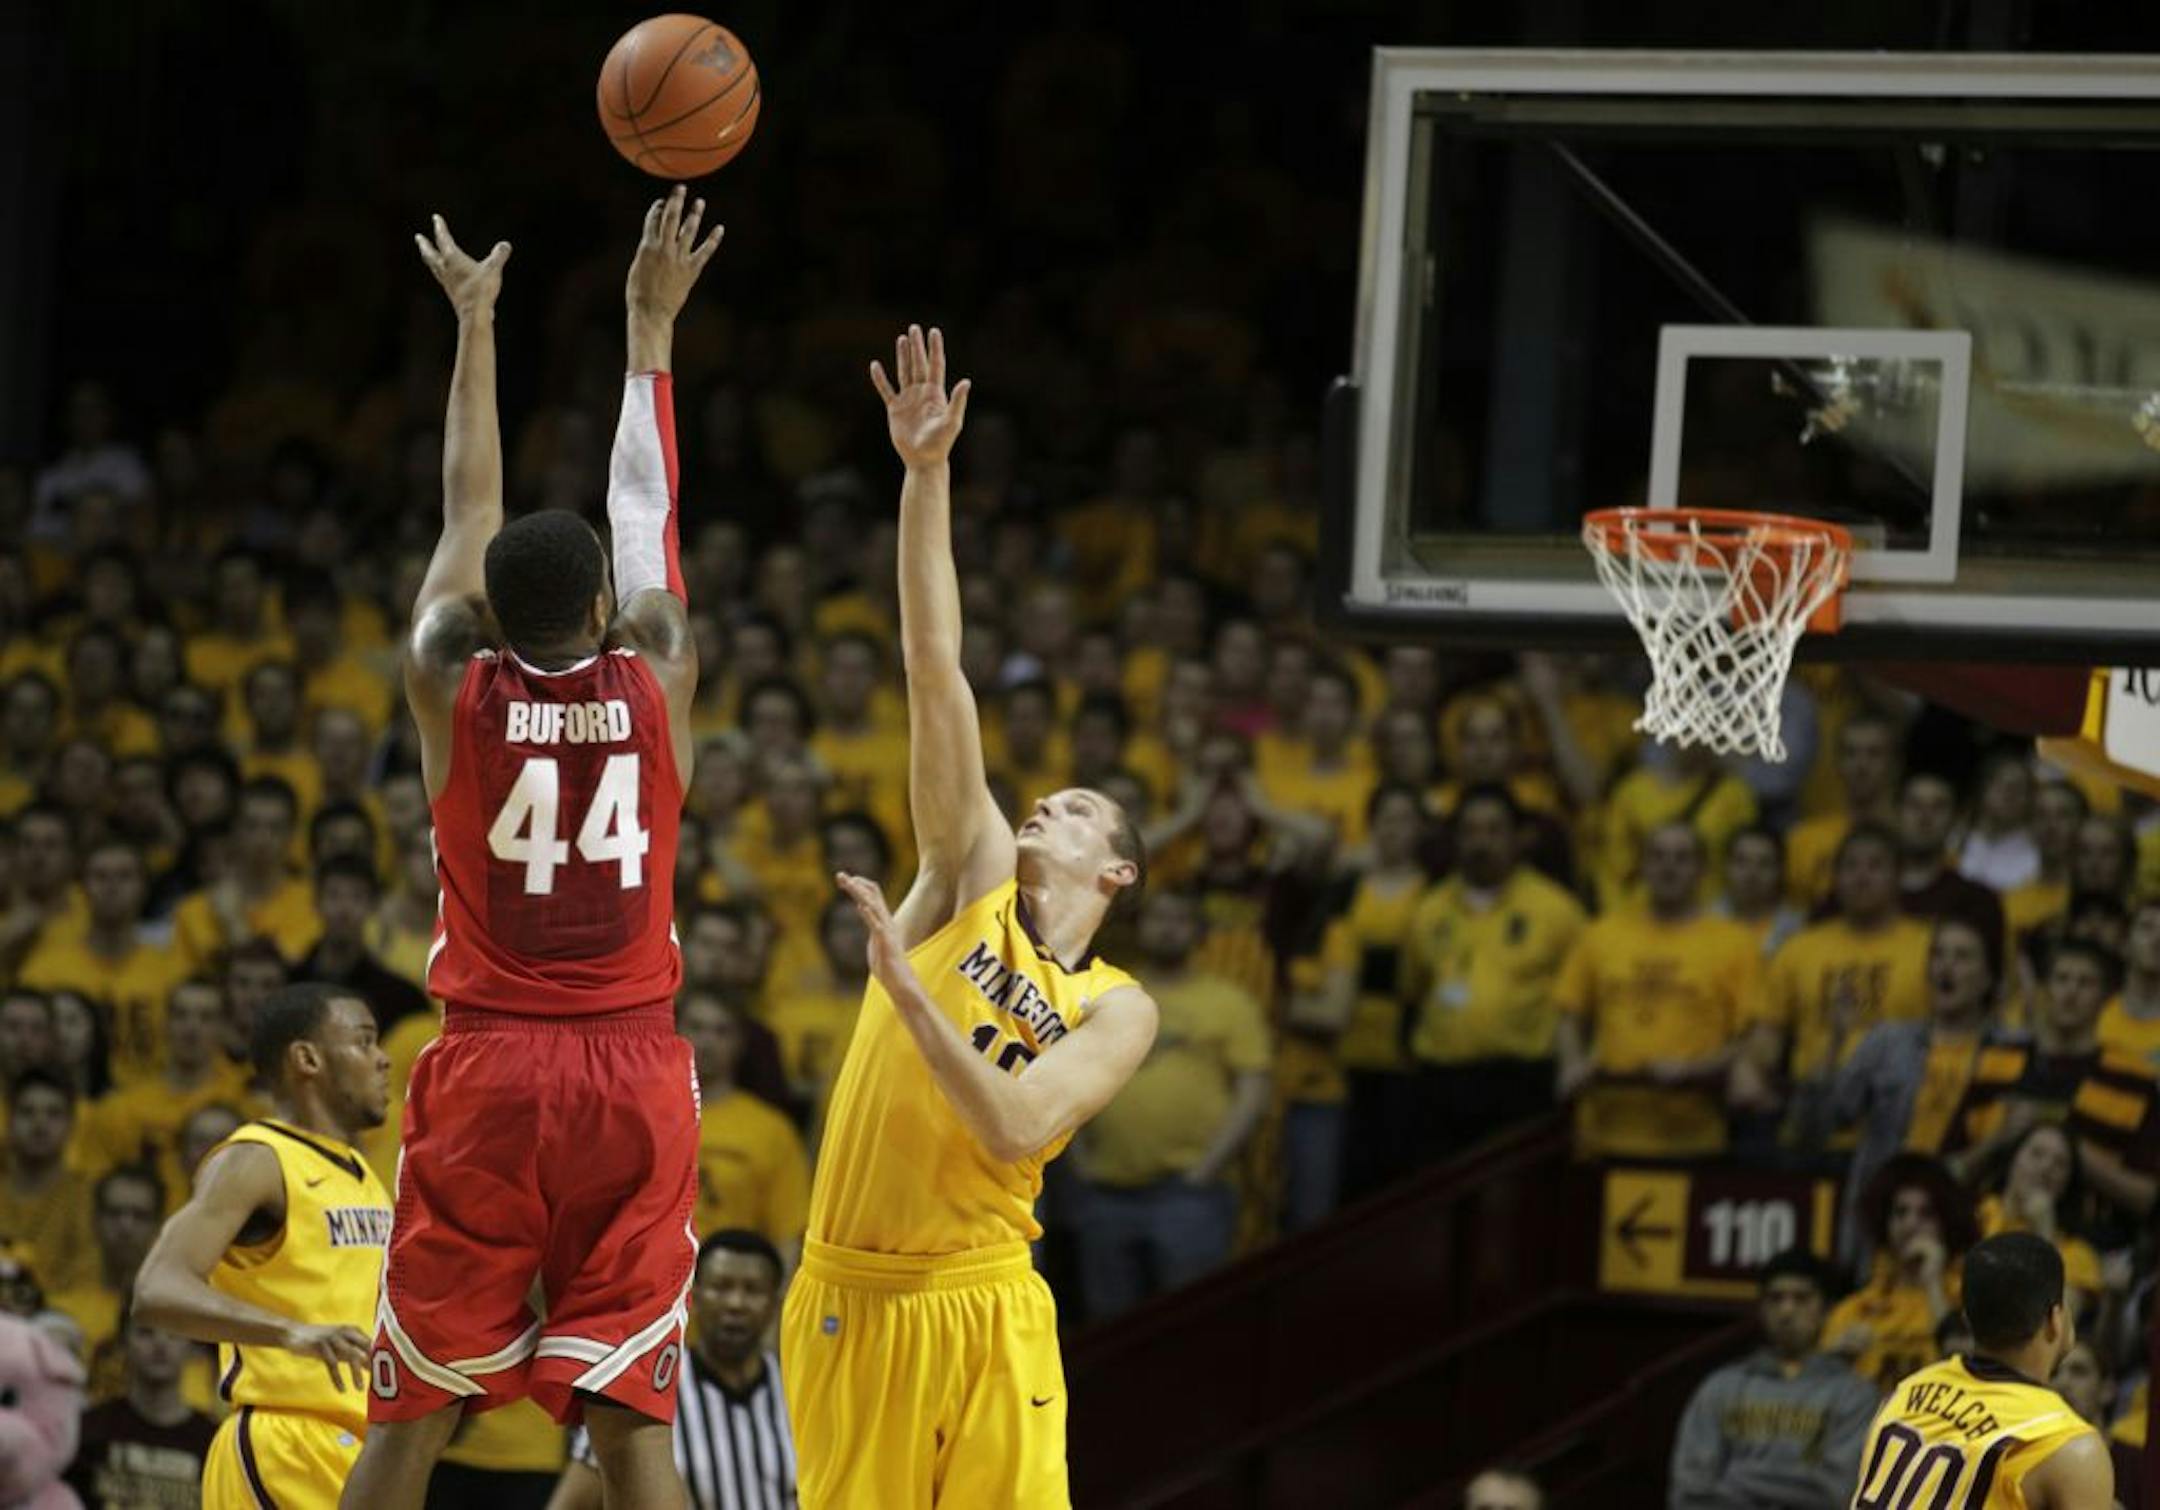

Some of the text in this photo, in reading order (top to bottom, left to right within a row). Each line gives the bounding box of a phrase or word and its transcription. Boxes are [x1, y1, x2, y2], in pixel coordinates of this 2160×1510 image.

[506, 700, 632, 744] BUFORD
[487, 753, 649, 894] 44
[1704, 1199, 1795, 1266] 110
[1905, 1382, 1999, 1440] WELCH
